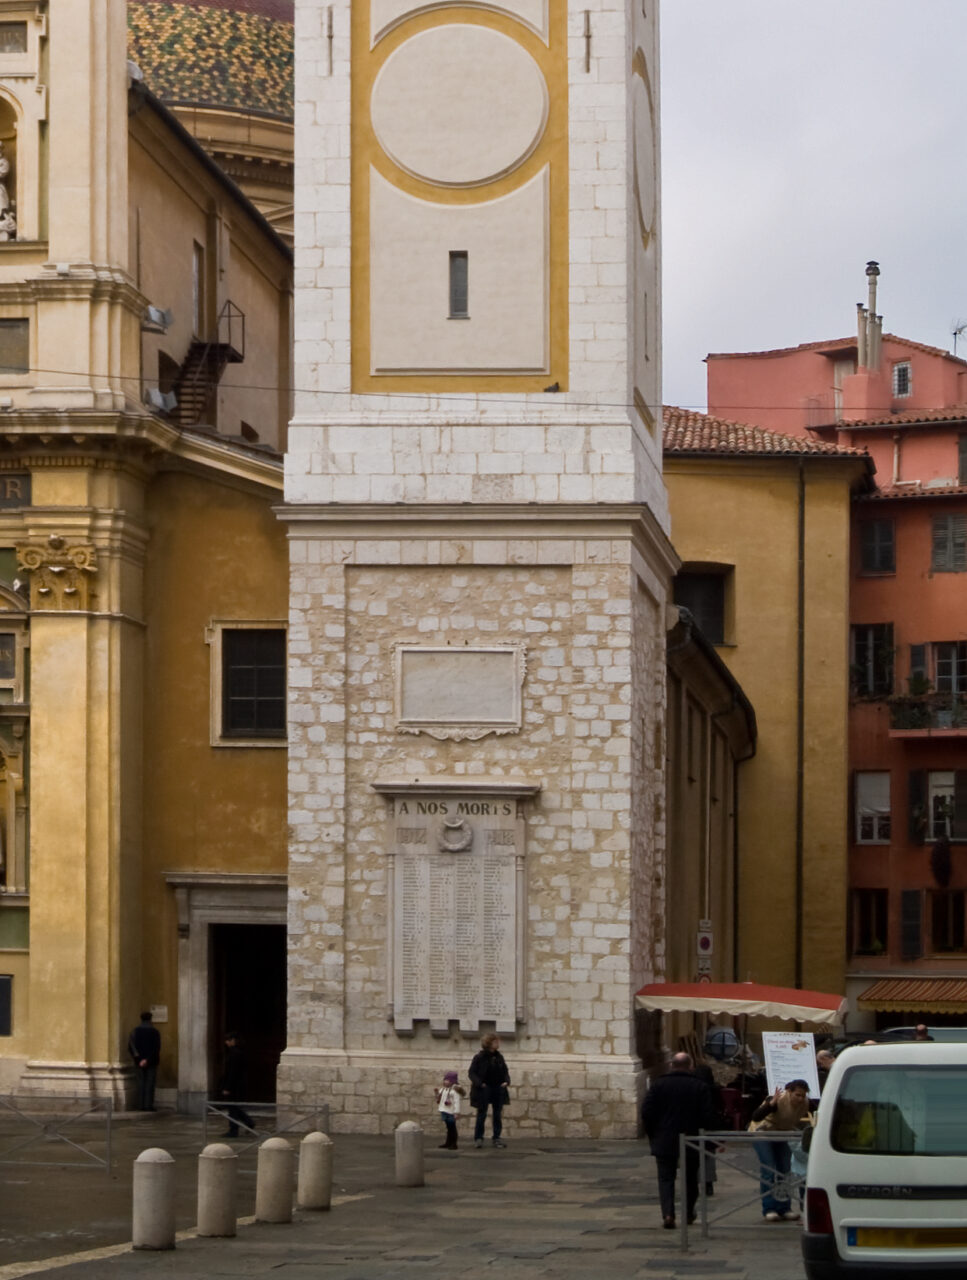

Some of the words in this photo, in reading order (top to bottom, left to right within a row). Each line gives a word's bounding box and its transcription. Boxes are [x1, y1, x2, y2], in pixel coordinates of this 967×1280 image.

[399, 802, 410, 815] A
[417, 801, 448, 815] NOS
[847, 1185, 913, 1197] CITROËN
